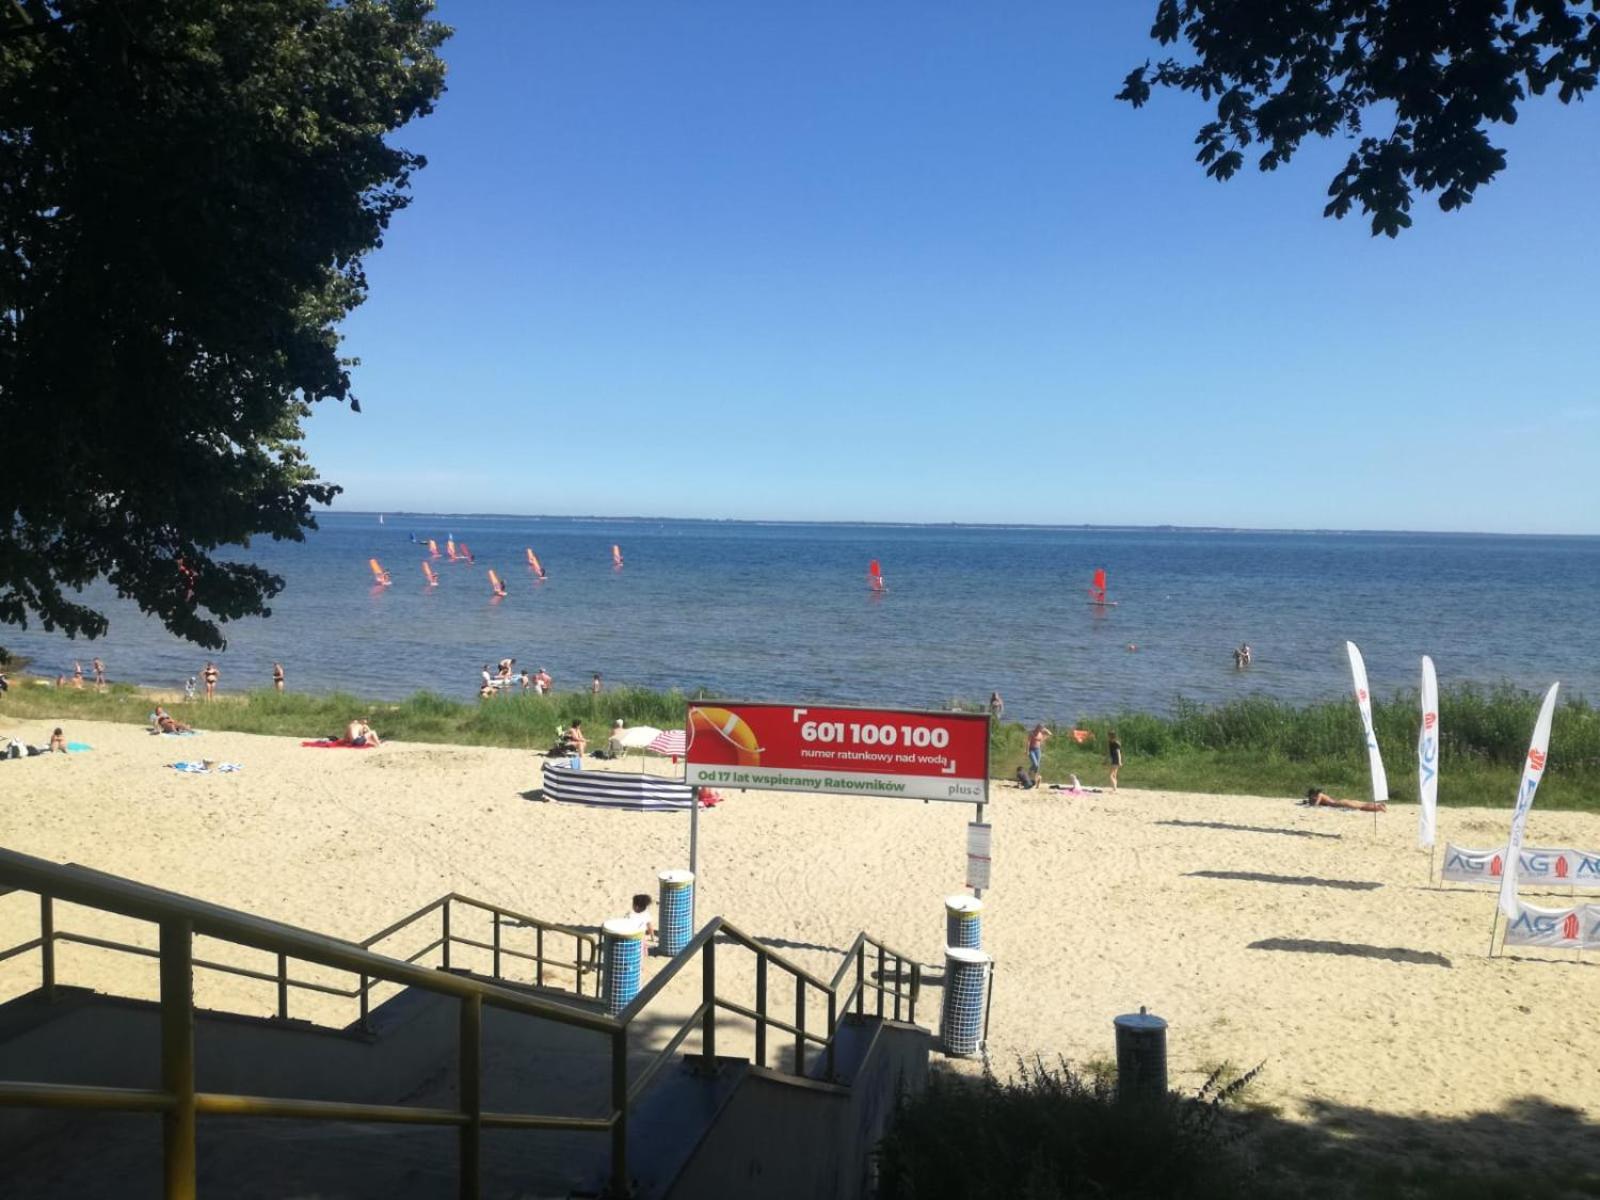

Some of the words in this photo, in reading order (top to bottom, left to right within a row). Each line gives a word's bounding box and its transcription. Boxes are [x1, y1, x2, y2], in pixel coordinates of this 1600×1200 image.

[801, 721, 845, 743] 601
[850, 723, 897, 746] 100
[901, 726, 949, 748] 100
[801, 749, 835, 758] numer
[837, 750, 893, 763] ratunkowy
[895, 753, 916, 763] nad
[918, 754, 948, 766] wodą
[698, 770, 716, 781] Od
[718, 771, 731, 781] 17
[734, 772, 750, 783] lat
[752, 773, 821, 789] wspieramy
[824, 777, 906, 792] Ratowników
[948, 784, 972, 796] plus
